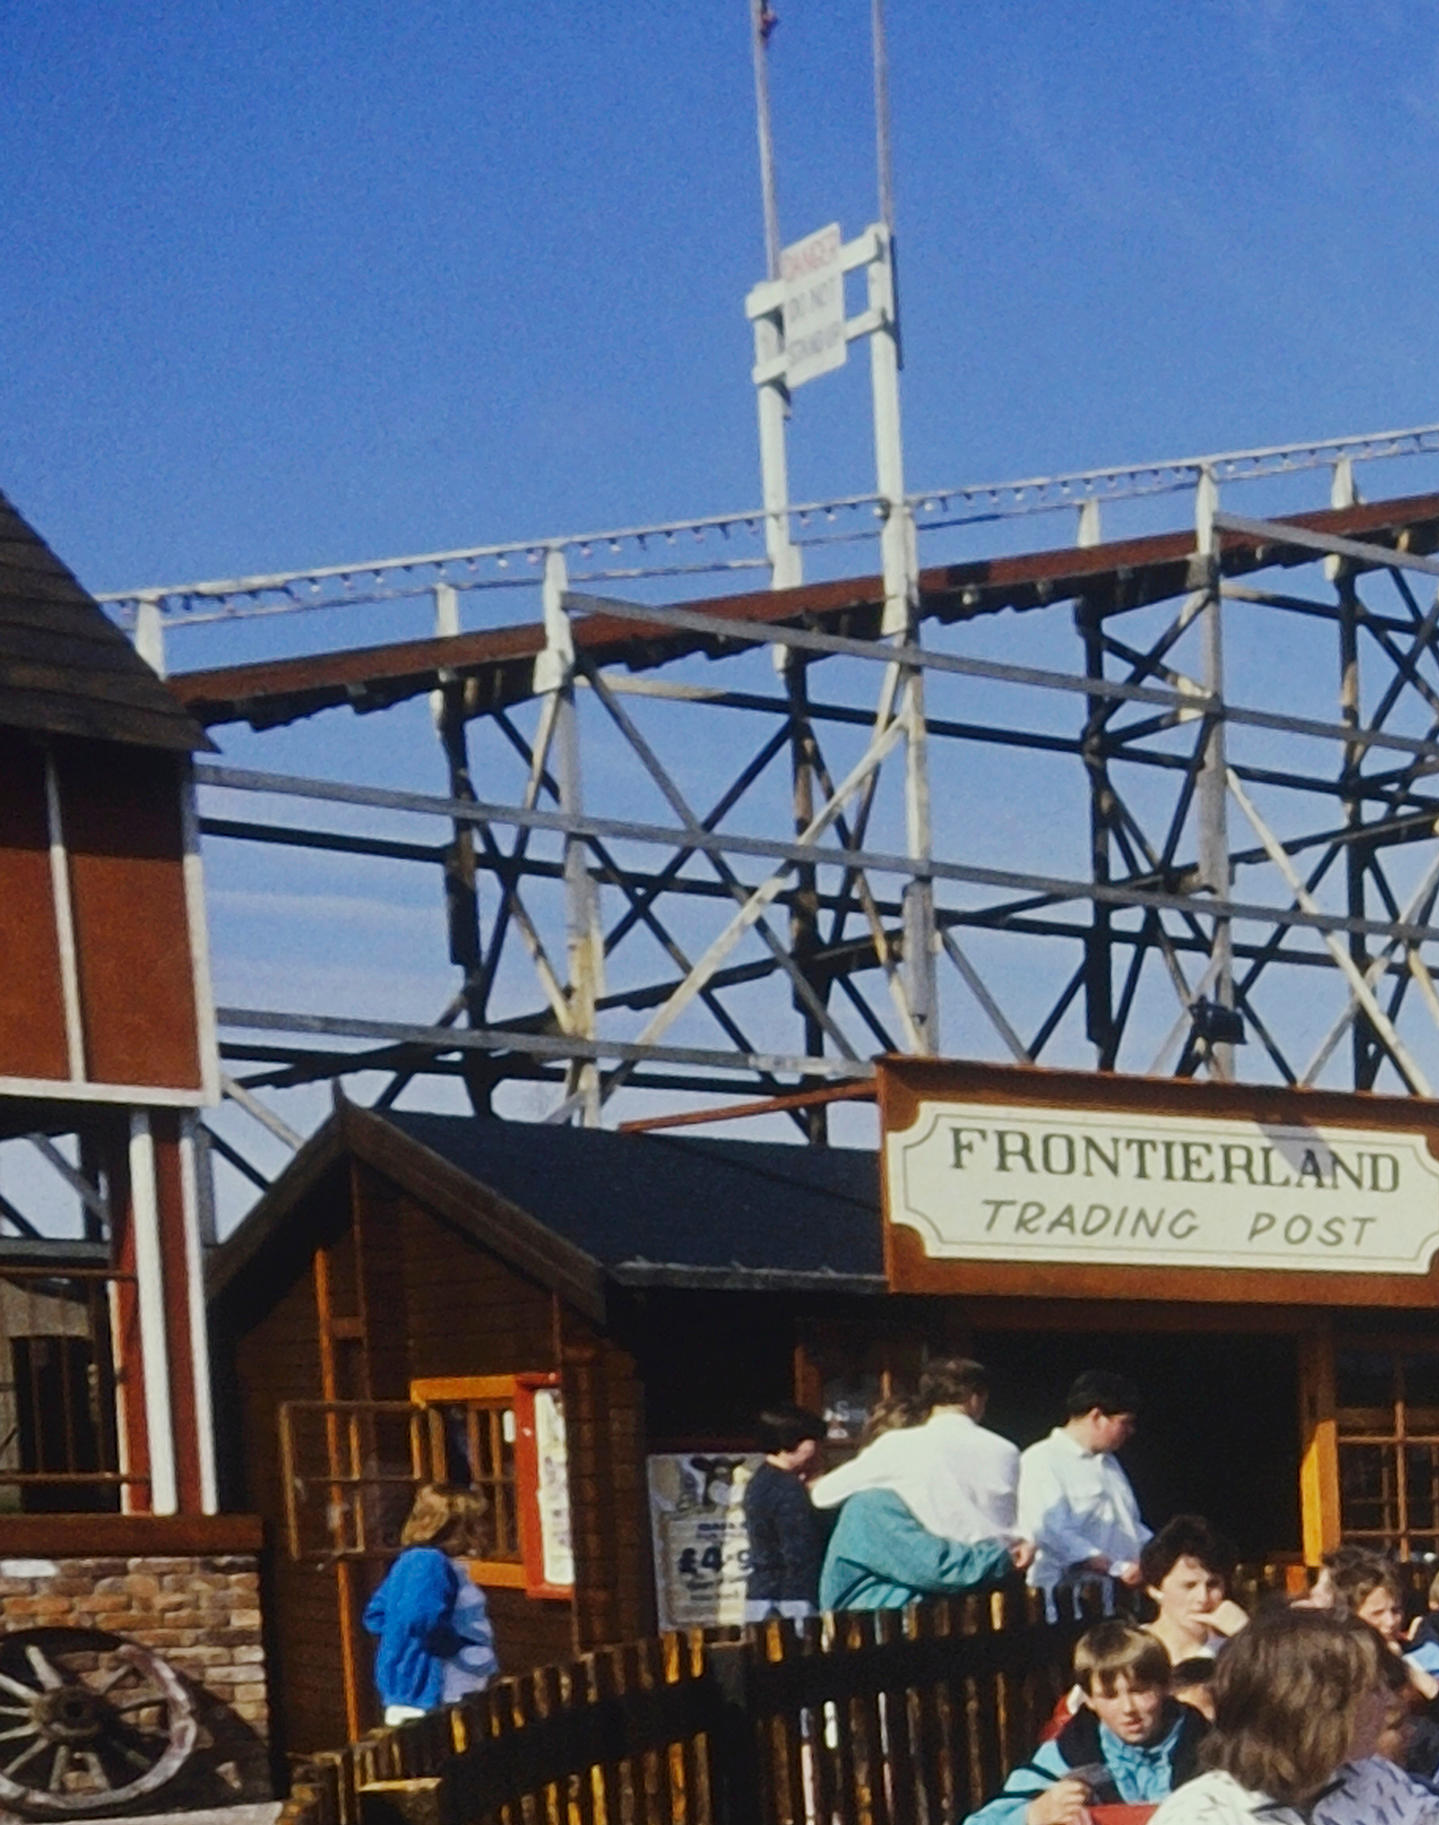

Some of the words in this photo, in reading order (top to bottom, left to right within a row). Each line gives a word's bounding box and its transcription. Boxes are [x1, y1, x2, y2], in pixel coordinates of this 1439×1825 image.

[948, 1125, 1401, 1192] FRONTIERLAND
[981, 1199, 1201, 1239] TRADING
[1247, 1211, 1377, 1247] POST
